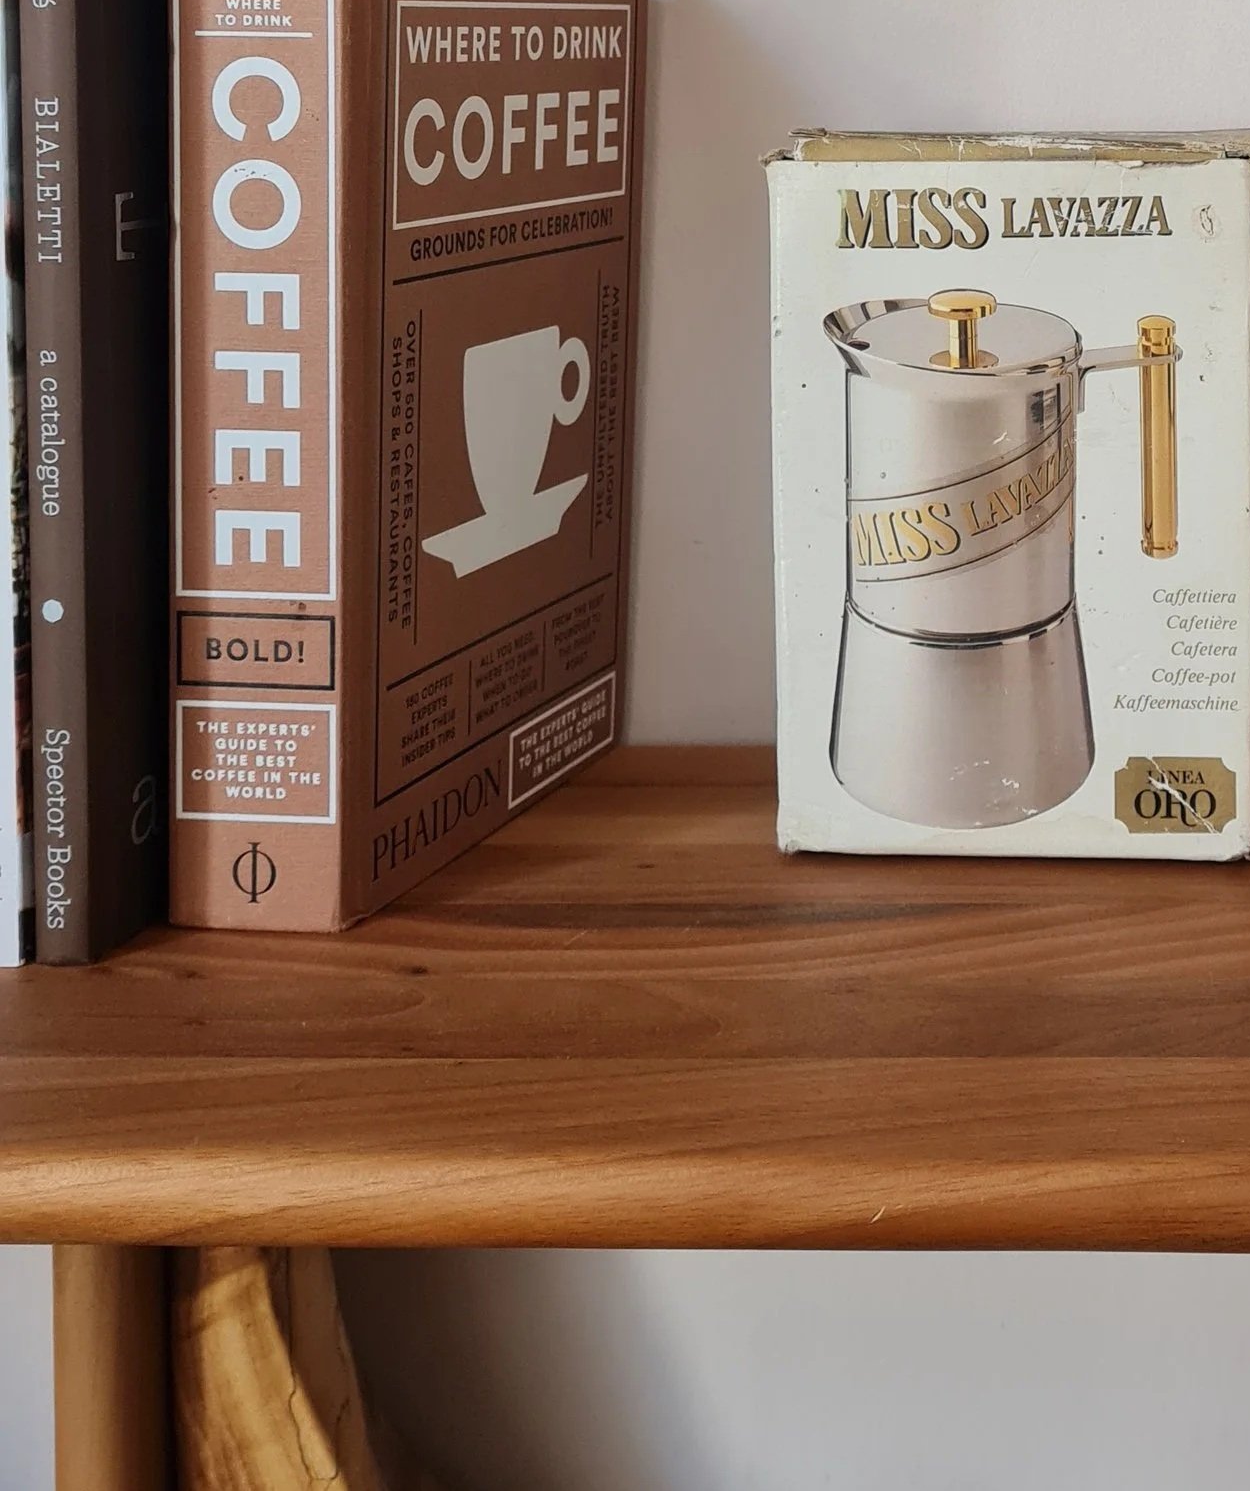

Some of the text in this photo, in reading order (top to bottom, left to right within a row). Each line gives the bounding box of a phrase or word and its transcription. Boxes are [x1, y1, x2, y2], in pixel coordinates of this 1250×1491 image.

[215, 14, 293, 27] TO DRINK
[406, 25, 622, 64] WHERE TO DRINK
[404, 89, 620, 186] COFFEE
[34, 97, 62, 263] BIALETTI
[836, 187, 1173, 250] MISS LAVAZZA
[410, 207, 613, 262] GROUNDS FOR CELEBRATION!
[212, 56, 301, 568] COFFEE
[406, 320, 416, 384] OVER
[36, 349, 66, 516] a catalogue
[388, 337, 402, 623] SHOPS & RESTAURANTS
[852, 502, 961, 567] MISS
[401, 536, 413, 629] COFFEE
[1152, 588, 1237, 606] Caffettiera
[1166, 615, 1238, 632] Cafetière
[206, 638, 305, 663] BOLD!
[1171, 641, 1238, 659] Cafetera
[421, 673, 454, 700] COFFEE
[1151, 668, 1236, 686] Coffee-pot
[1113, 694, 1241, 712] Kaffeemaschine
[196, 721, 229, 734] THE
[521, 732, 538, 752] THE
[215, 738, 297, 752] GUIDE TO
[519, 753, 532, 770] TO
[534, 740, 551, 760] THE
[216, 754, 297, 768] THE BEST
[191, 769, 321, 785] COFFEE IN THE
[225, 786, 287, 799] WORLD
[372, 760, 502, 882] PHAIDON
[1134, 789, 1217, 827] ORO
[41, 728, 72, 929] Spector Books
